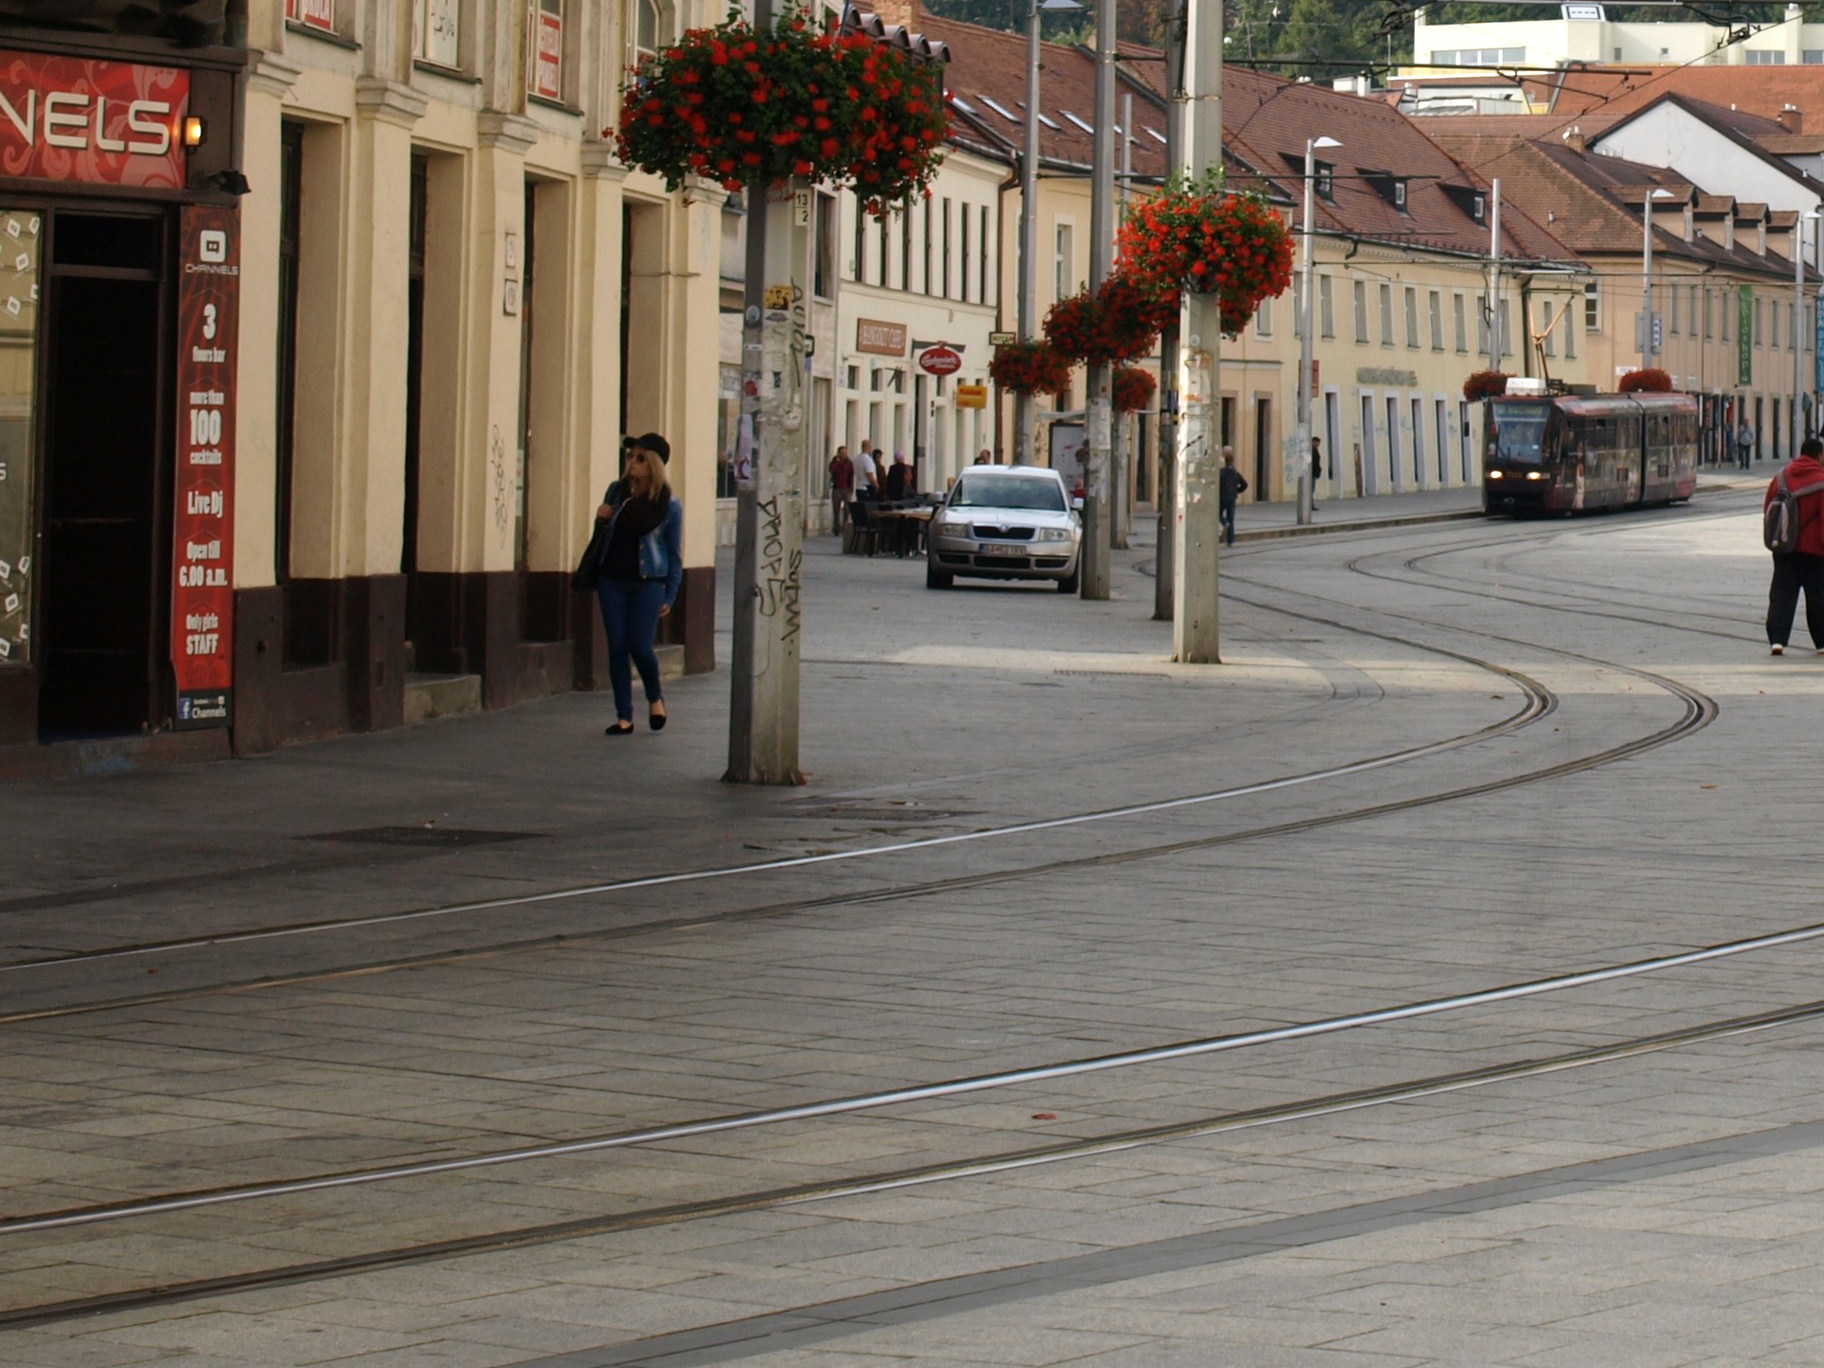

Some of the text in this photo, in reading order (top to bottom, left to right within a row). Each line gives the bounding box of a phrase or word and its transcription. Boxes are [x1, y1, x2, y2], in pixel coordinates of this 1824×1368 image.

[797, 193, 808, 208] 13
[802, 209, 808, 223] 2
[185, 263, 239, 275] CHANNELS
[203, 303, 217, 340] 3
[192, 345, 226, 363] floors bar
[190, 389, 225, 405] more than
[190, 408, 221, 446] 100
[190, 449, 222, 464] cocktails
[187, 490, 223, 518] Live Dj
[186, 540, 221, 563] Open till
[179, 565, 228, 587] 6.00 a.m.
[186, 613, 218, 632] Only girls
[186, 633, 219, 655] STAFF
[192, 706, 226, 719] Channels
